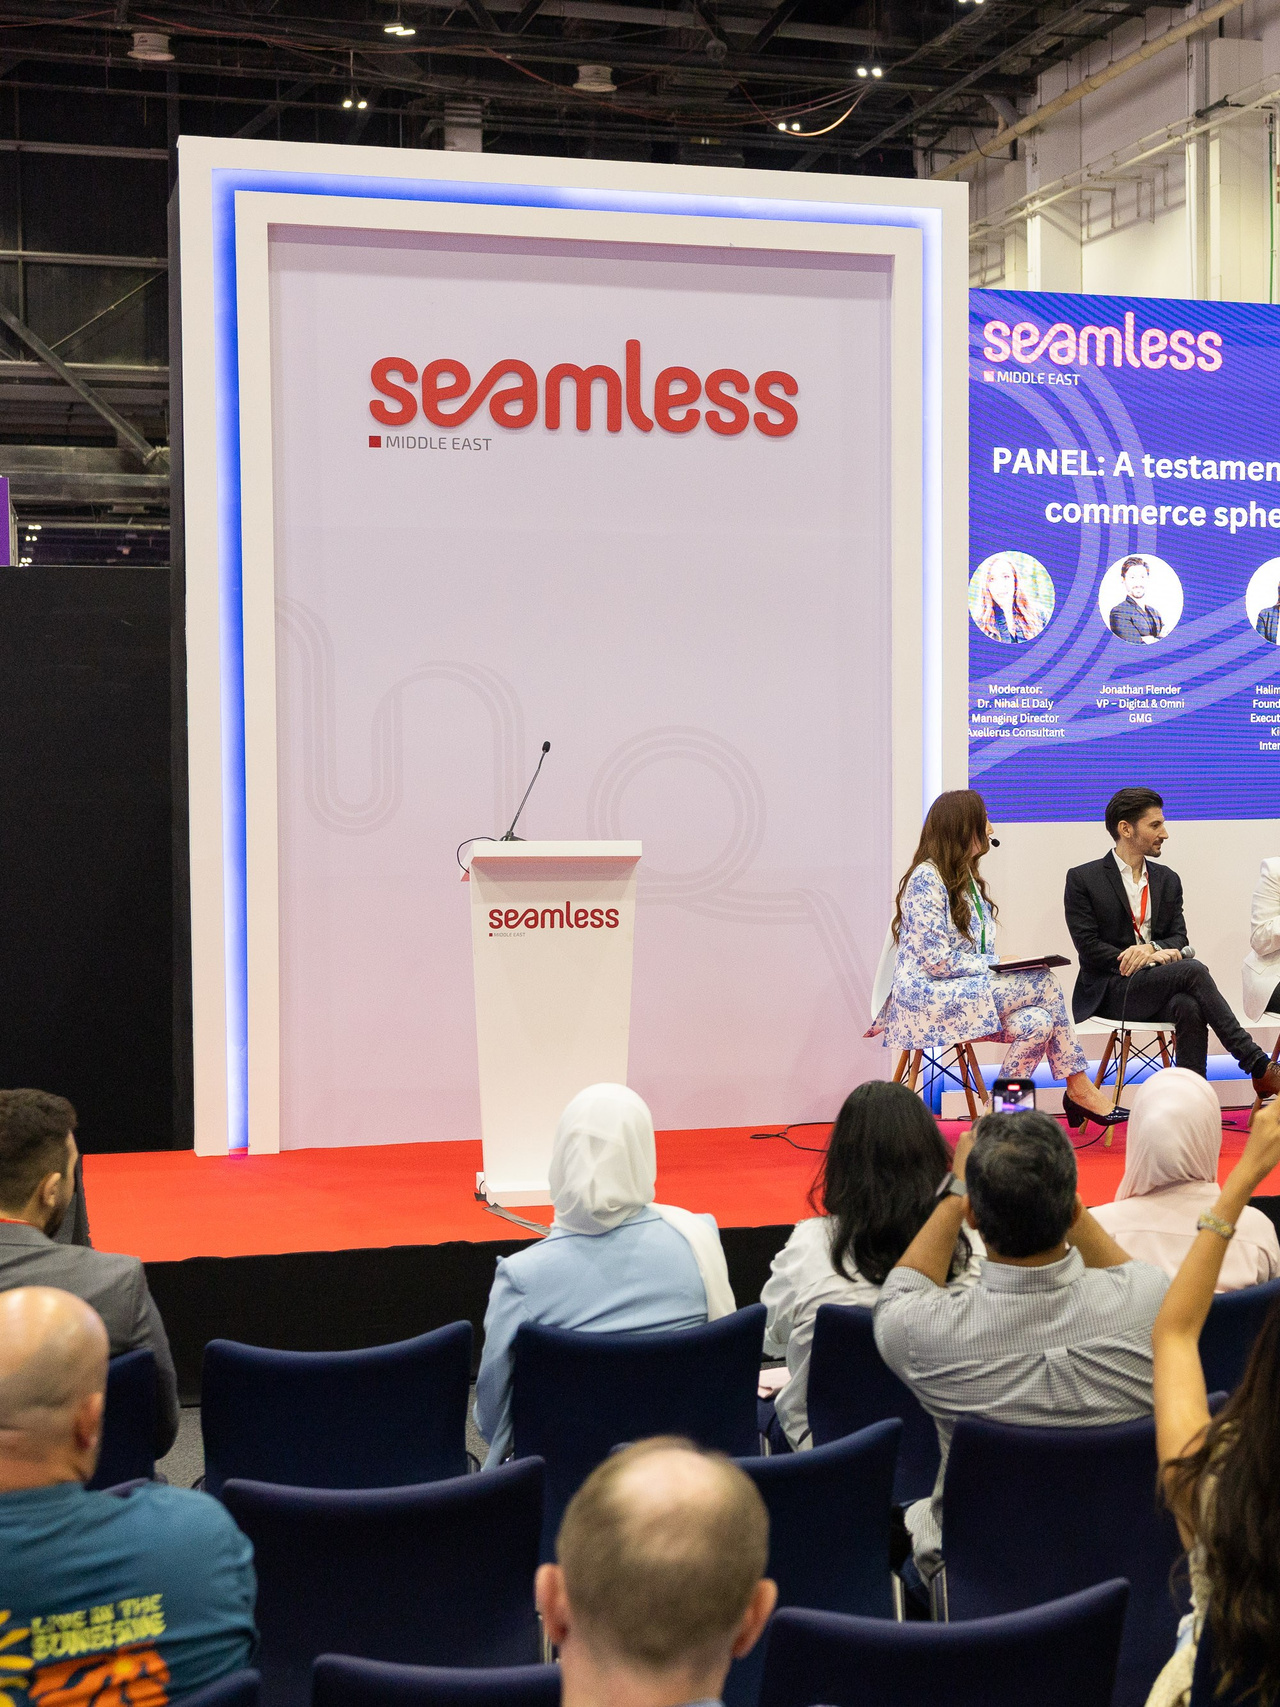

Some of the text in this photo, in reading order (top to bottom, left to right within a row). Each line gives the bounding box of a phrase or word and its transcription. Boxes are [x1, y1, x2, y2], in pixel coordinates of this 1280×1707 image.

[983, 311, 1223, 372] seamless
[997, 371, 1080, 385] MIDDLE EAST
[369, 338, 798, 437] seamless
[386, 435, 492, 451] MIDDLE EAST
[993, 447, 1105, 476] PANEL:
[1113, 451, 1134, 477] A
[1045, 502, 1206, 526] commerce
[989, 684, 1043, 694] Moderator:
[1100, 684, 1182, 694] Jonathan Flender
[977, 698, 1054, 710] Dr. Nihal El Daly
[1096, 699, 1110, 708] VP
[1119, 698, 1150, 710] Digital
[1151, 699, 1158, 708] &
[1160, 699, 1185, 708] Omni
[971, 713, 1060, 725] Managing Director
[1129, 713, 1152, 723] GMG
[1012, 728, 1066, 737] Consultant
[488, 900, 620, 930] seamless
